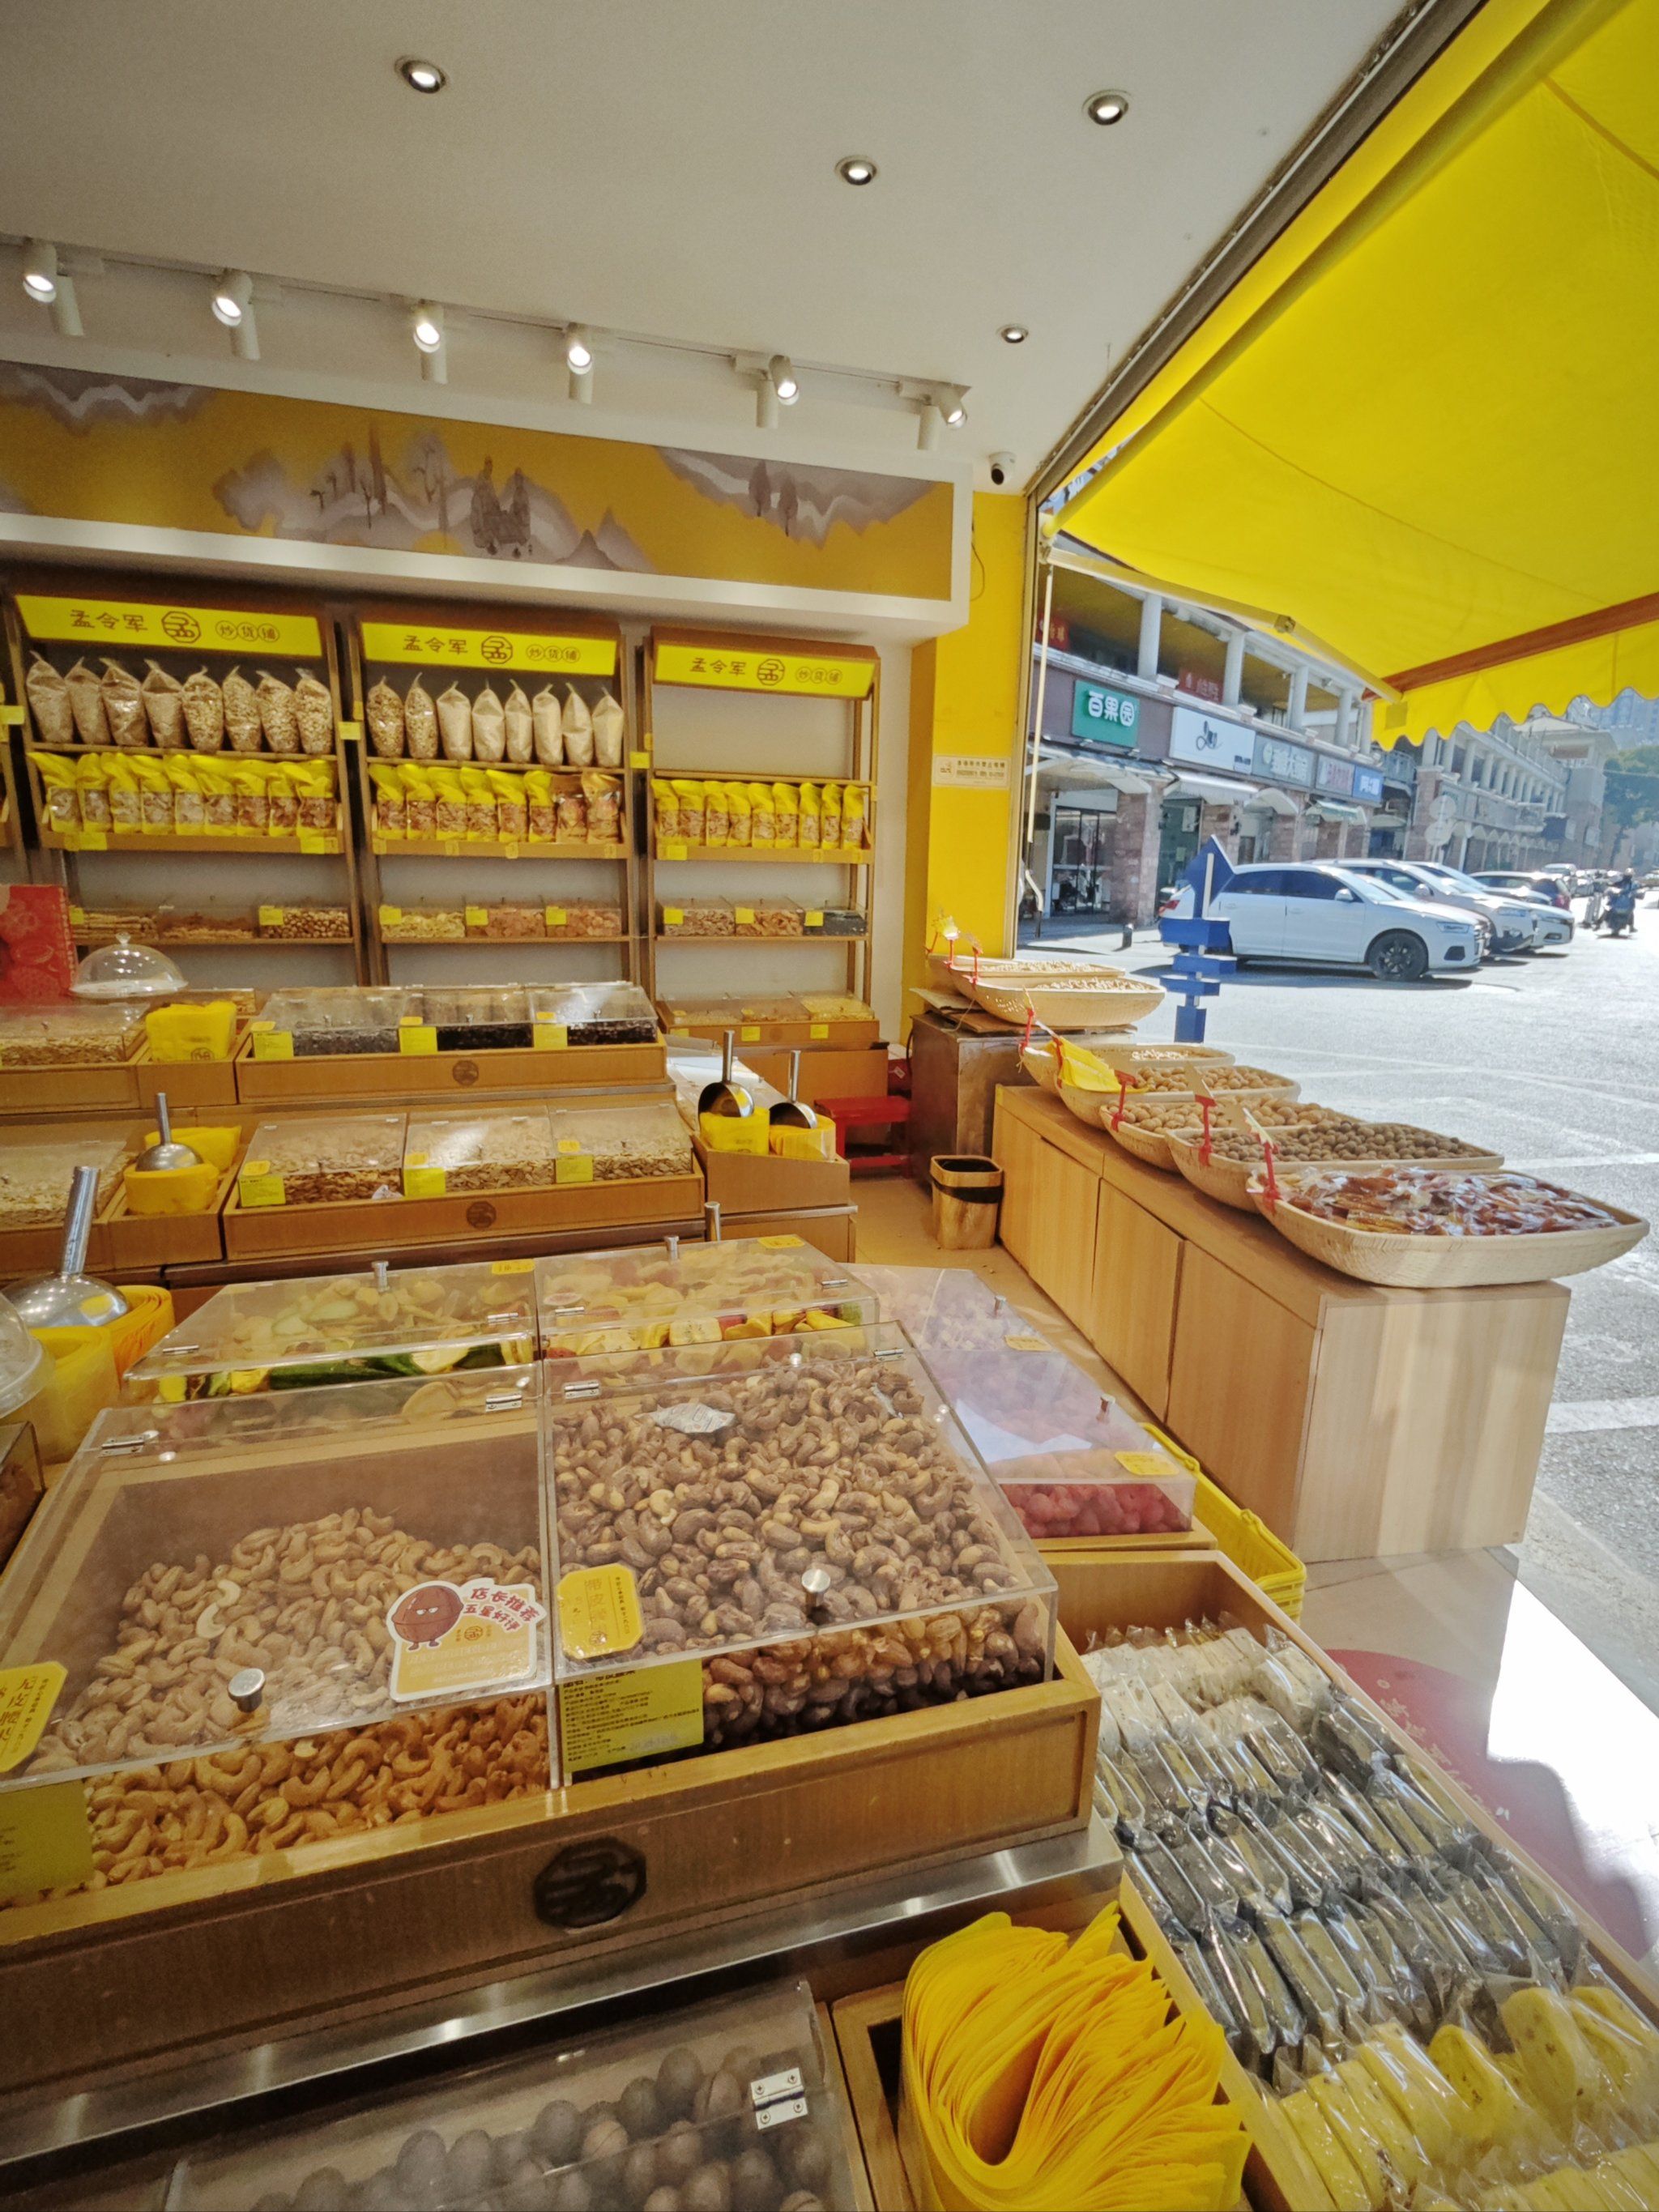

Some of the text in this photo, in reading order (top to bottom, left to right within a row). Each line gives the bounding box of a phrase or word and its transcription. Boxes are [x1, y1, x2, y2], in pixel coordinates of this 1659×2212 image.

[70, 609, 148, 633] 孟令军
[403, 635, 468, 655] 孟令军
[689, 657, 747, 676] 孟令军
[1088, 690, 1135, 727] 百果园
[463, 1604, 520, 1631] 五星好评
[471, 1588, 540, 1622] 店长推荐
